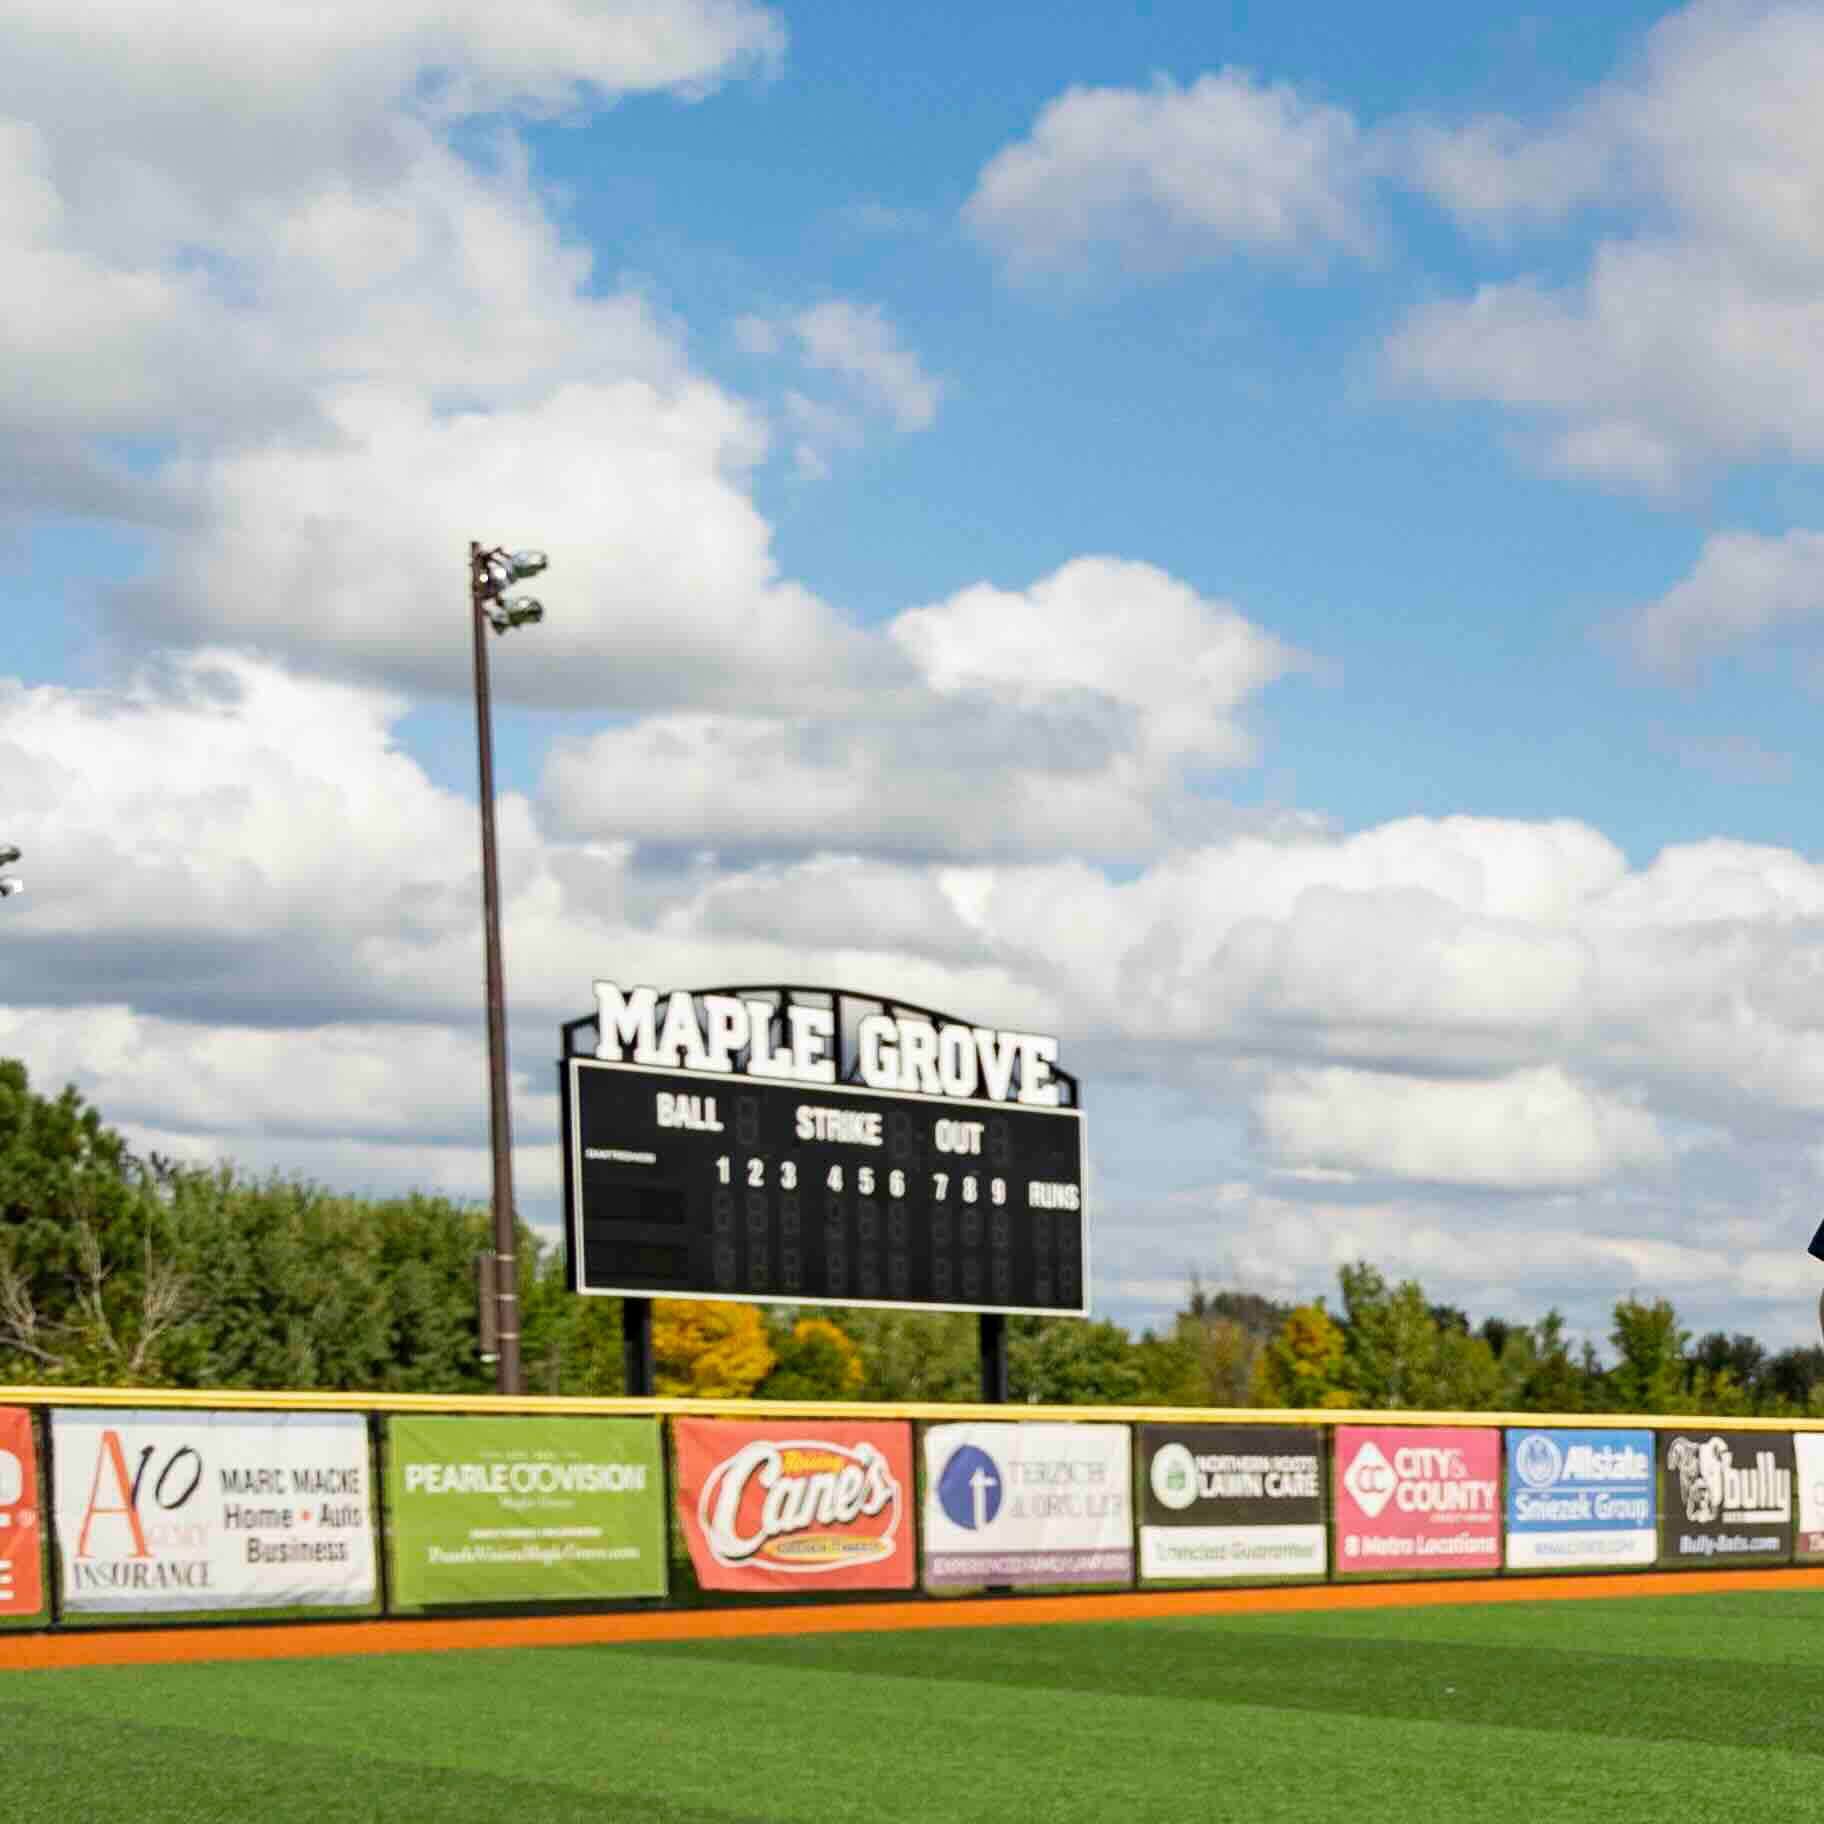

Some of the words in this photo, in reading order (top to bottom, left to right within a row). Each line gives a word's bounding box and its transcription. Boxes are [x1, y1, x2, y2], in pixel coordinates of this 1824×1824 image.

[593, 980, 837, 1083] MAPLE
[857, 1014, 1059, 1106] GROVE
[656, 1092, 724, 1132] BALL
[796, 1104, 883, 1147] STRIKE
[935, 1119, 984, 1155] OUT
[716, 1156, 730, 1185] 1
[746, 1157, 765, 1188] 2
[780, 1161, 798, 1191] 3
[826, 1164, 844, 1193] 4
[857, 1167, 875, 1196] 5
[888, 1169, 905, 1198] 6
[933, 1172, 949, 1202] 7
[961, 1175, 978, 1204] 8
[991, 1178, 1007, 1206] 9
[1028, 1180, 1080, 1211] RUNS
[1561, 1445, 1649, 1480] Allstate
[220, 1469, 285, 1494] MARC
[1264, 1472, 1320, 1498] CARE
[1396, 1479, 1498, 1512] COUNTY
[1722, 1451, 1791, 1524] bully
[224, 1504, 293, 1529] Home
[319, 1503, 362, 1528] Auto
[711, 1440, 897, 1561] Cane's
[247, 1536, 347, 1563] Business
[72, 1561, 213, 1589] INSURANCE
